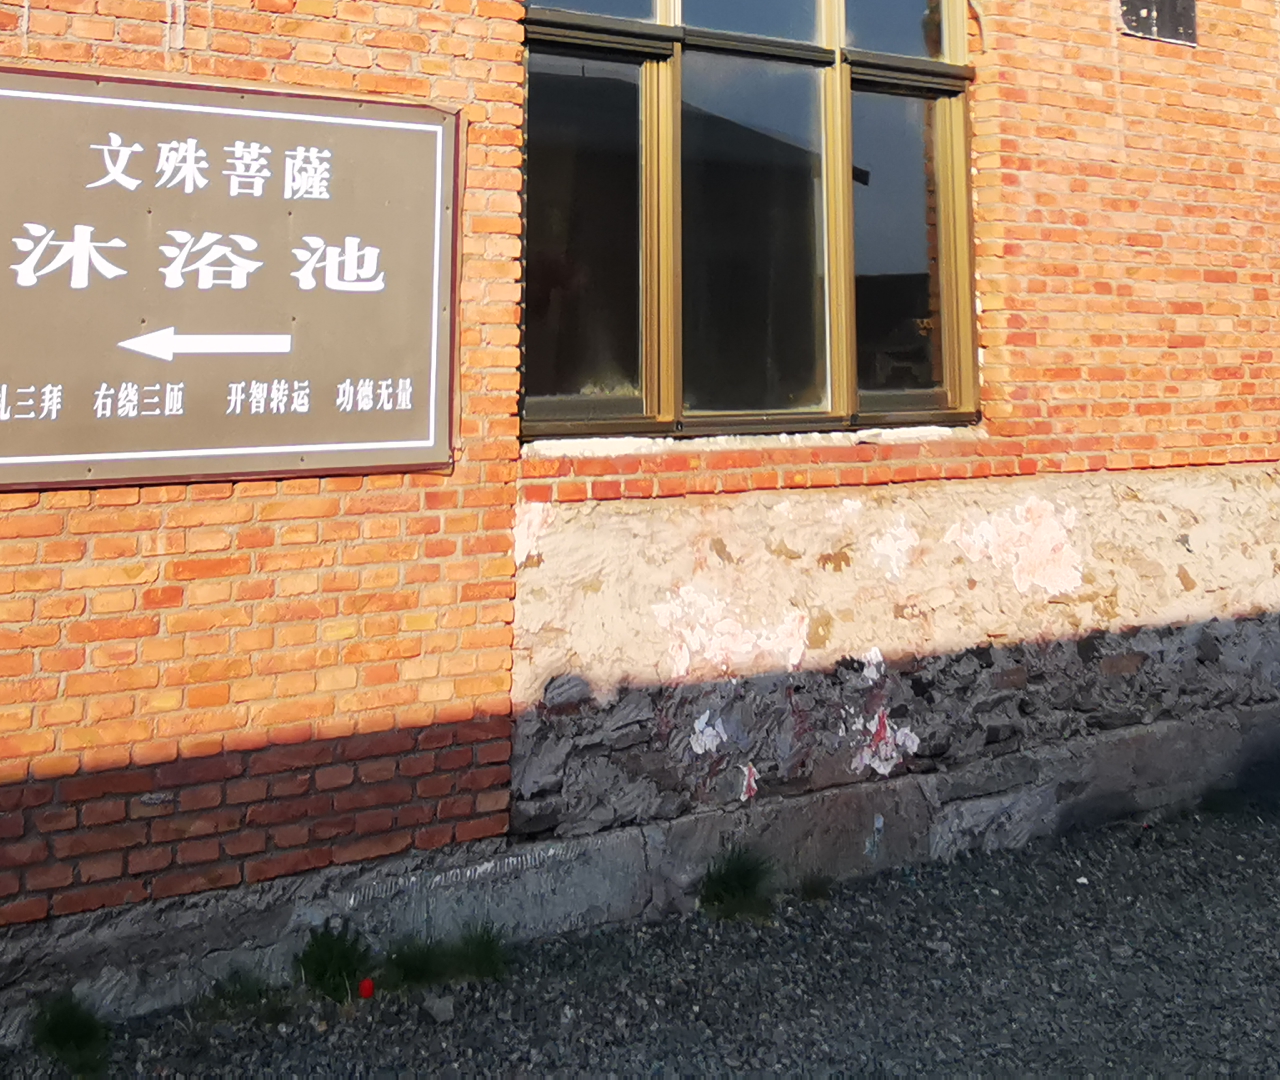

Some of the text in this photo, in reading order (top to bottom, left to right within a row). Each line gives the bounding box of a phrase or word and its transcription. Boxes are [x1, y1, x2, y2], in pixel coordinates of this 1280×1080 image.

[86, 131, 332, 200] 文殊菩薩
[10, 222, 386, 292] 沐浴池
[93, 381, 185, 419] 右绕三匝
[225, 378, 310, 415] 开智转运
[335, 377, 413, 412] 功德无量
